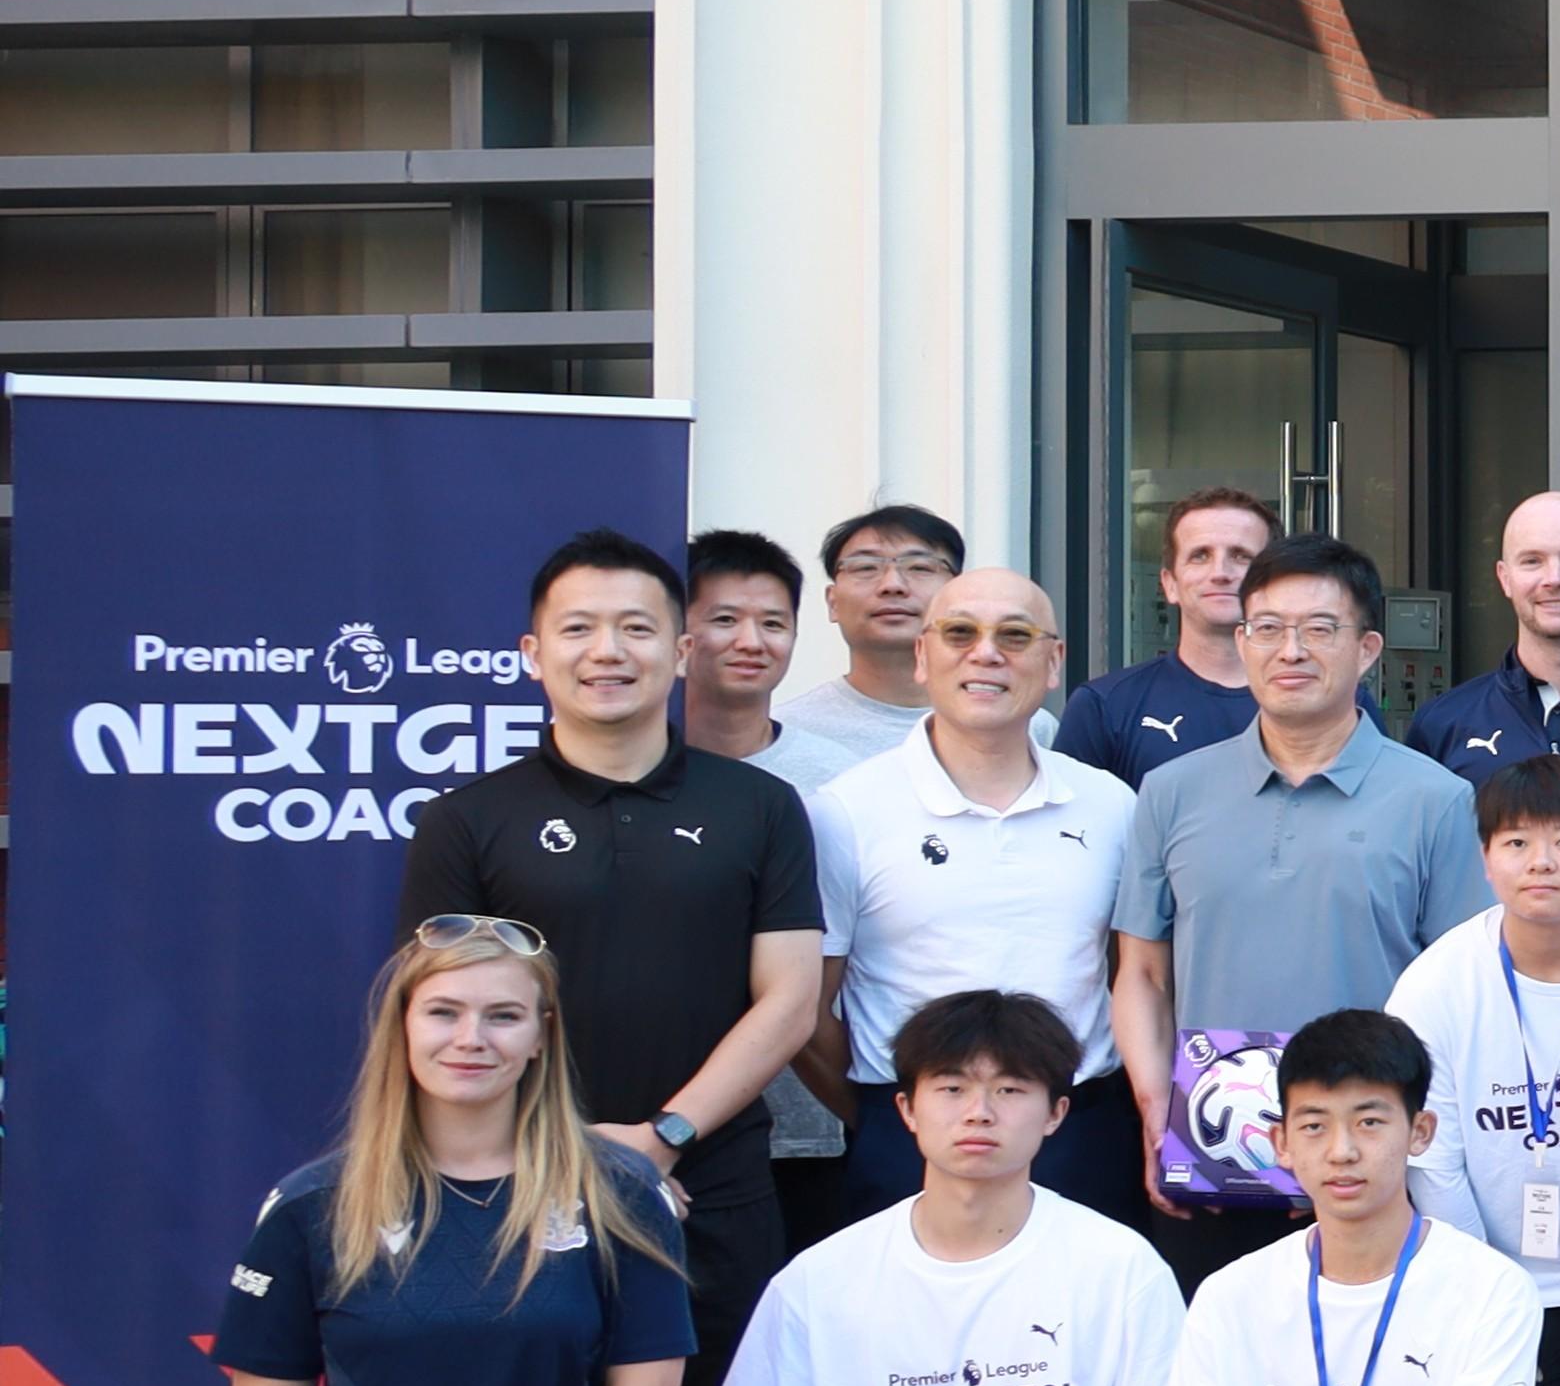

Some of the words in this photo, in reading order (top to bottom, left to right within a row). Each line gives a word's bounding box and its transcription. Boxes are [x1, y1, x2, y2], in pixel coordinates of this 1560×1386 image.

[135, 634, 313, 674] Premier
[406, 638, 530, 685] Leag
[72, 701, 546, 774] NEXTGE
[215, 787, 430, 842] COAC
[986, 1358, 1048, 1383] League
